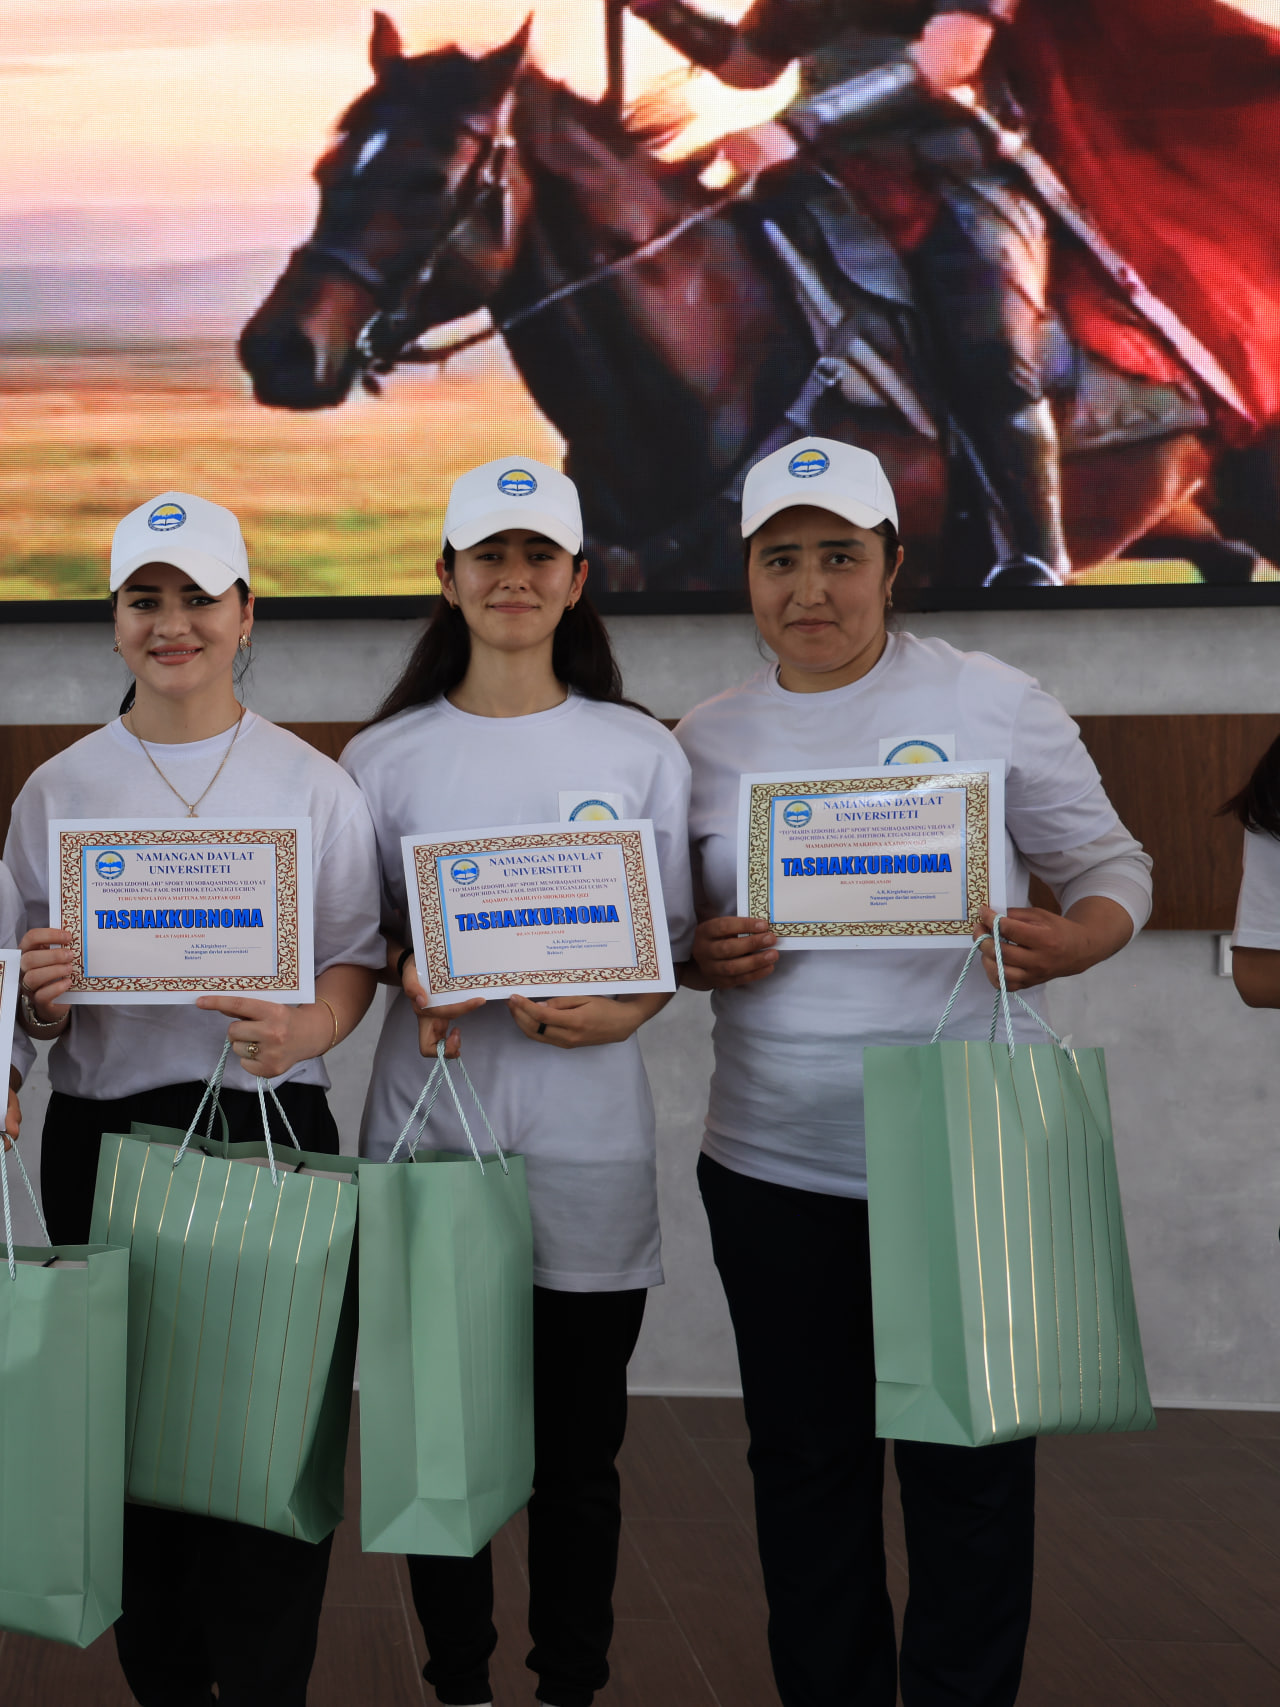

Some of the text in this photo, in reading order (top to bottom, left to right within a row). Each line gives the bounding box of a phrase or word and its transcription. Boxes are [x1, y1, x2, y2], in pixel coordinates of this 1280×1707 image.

[823, 796, 944, 810] NAMANGAN DAVLAT
[835, 810, 918, 822] UNIVERSITETI
[136, 851, 254, 862] NAMANGAN DAVLAT
[488, 851, 604, 866] NAMANGAN DAVLAT
[149, 865, 230, 874] UNIVERSITETI
[503, 863, 582, 877] UNIVERSITETI
[780, 853, 952, 876] TASHAKKURNOMA
[94, 908, 264, 929] TASHAKKURNOMA
[454, 903, 620, 932] TASHAKKURNOMA
